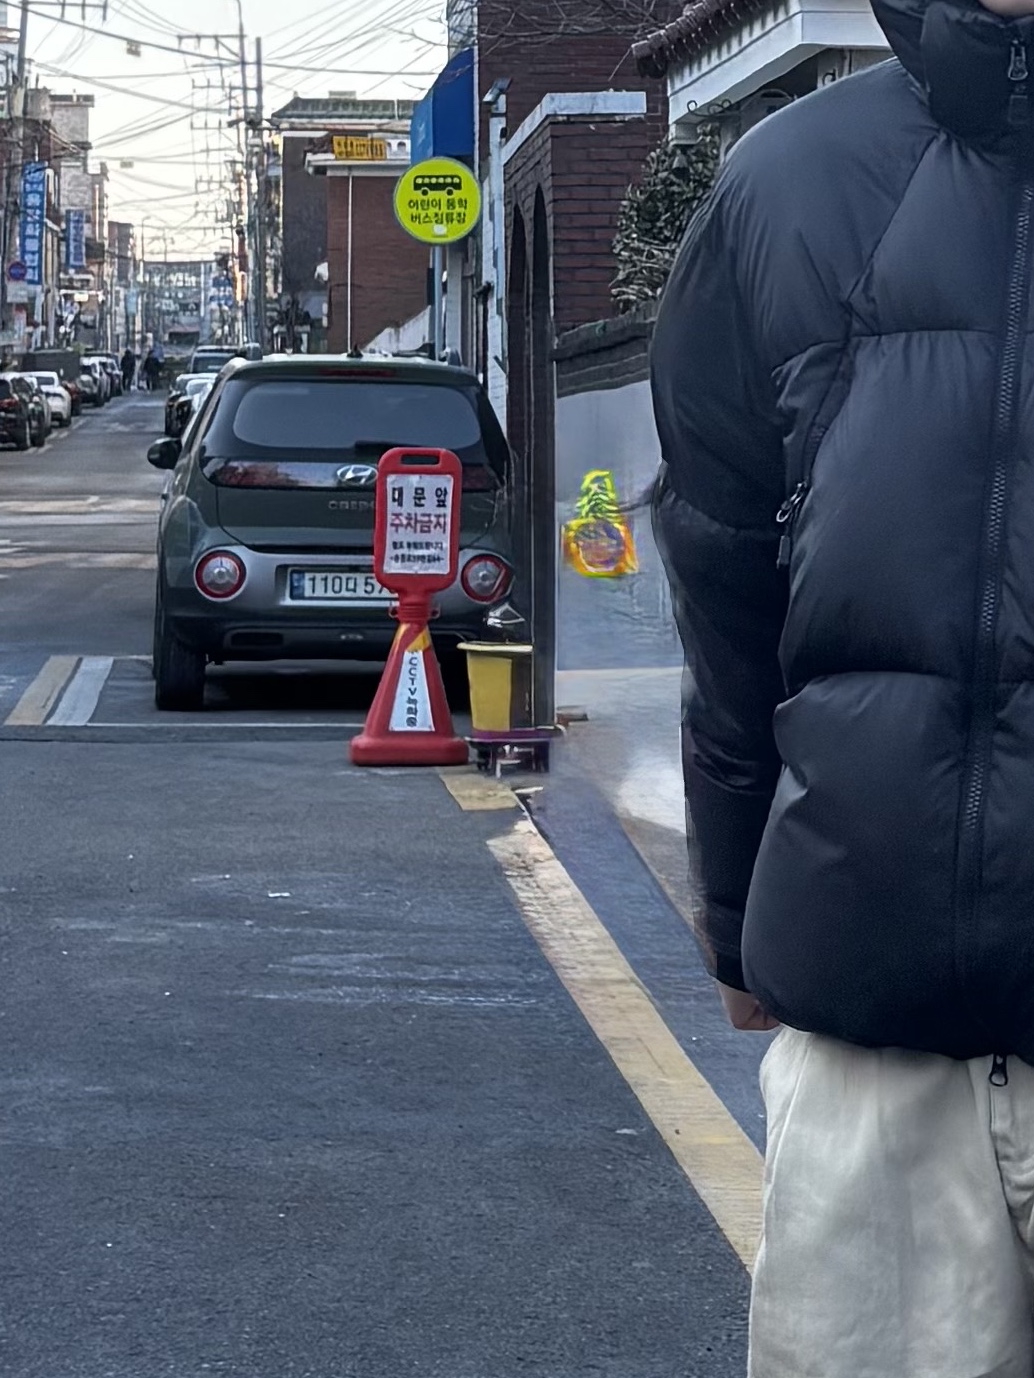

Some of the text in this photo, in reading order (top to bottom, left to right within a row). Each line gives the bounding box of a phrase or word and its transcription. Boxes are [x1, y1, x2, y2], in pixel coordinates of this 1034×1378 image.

[408, 198, 441, 210] 어린이
[411, 213, 466, 224] 버스정류장
[390, 513, 446, 534] 주차금지
